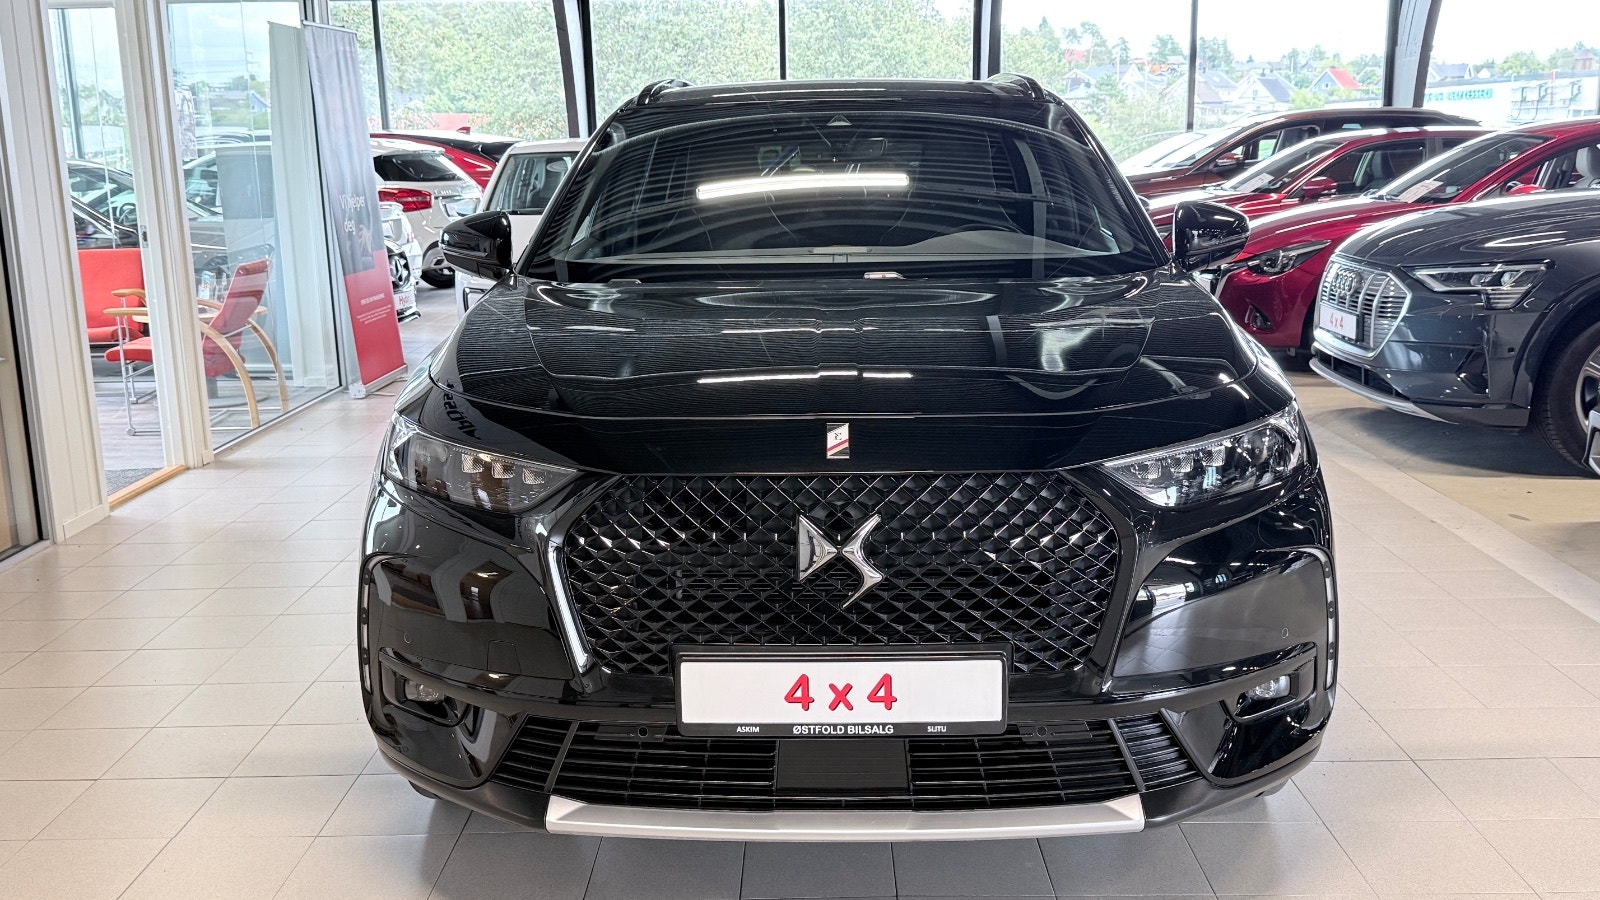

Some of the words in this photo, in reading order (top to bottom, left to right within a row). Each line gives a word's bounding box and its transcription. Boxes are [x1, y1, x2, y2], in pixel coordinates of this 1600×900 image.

[343, 217, 356, 236] deg
[784, 673, 815, 711] 4
[828, 682, 854, 711] x
[866, 672, 897, 711] 4
[736, 725, 760, 733] ASKIM
[792, 725, 845, 735] ØSTFOLD
[847, 724, 894, 735] BILSALG
[927, 725, 947, 733] SLITU
